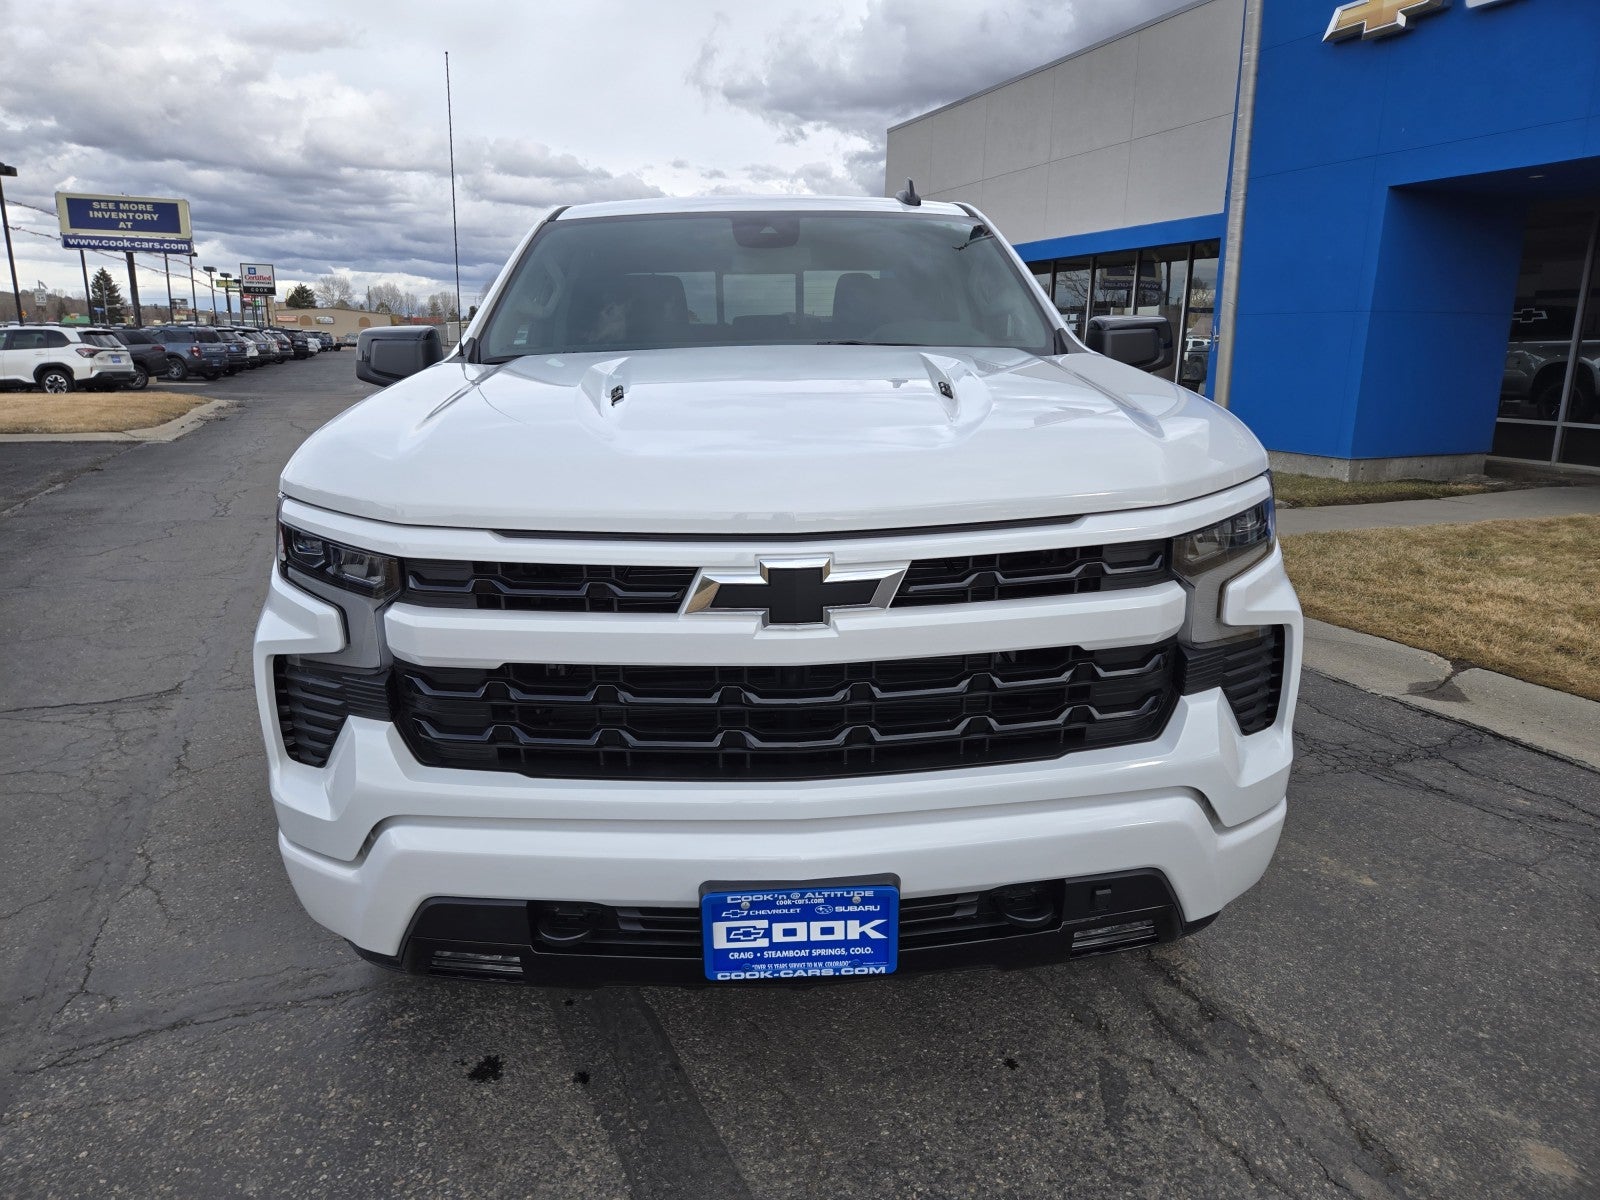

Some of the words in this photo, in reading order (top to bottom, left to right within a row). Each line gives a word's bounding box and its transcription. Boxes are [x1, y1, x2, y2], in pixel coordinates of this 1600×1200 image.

[92, 202, 116, 210] SEE
[119, 203, 154, 211] MORE
[89, 211, 159, 221] INVENTORY
[118, 221, 133, 229] AT
[67, 236, 189, 251] www.cook-cars.com
[804, 890, 874, 899] ALTITUDE
[776, 898, 825, 906] cook-cars.com
[749, 907, 801, 916] CHEVROLET
[835, 905, 880, 913] SUBARU
[712, 919, 888, 949] COOK
[763, 949, 810, 958] STEAMBOAT
[811, 948, 848, 957] SPRINGS,
[850, 946, 874, 955] COLO.
[716, 966, 887, 981] COOK-CARS.COM
